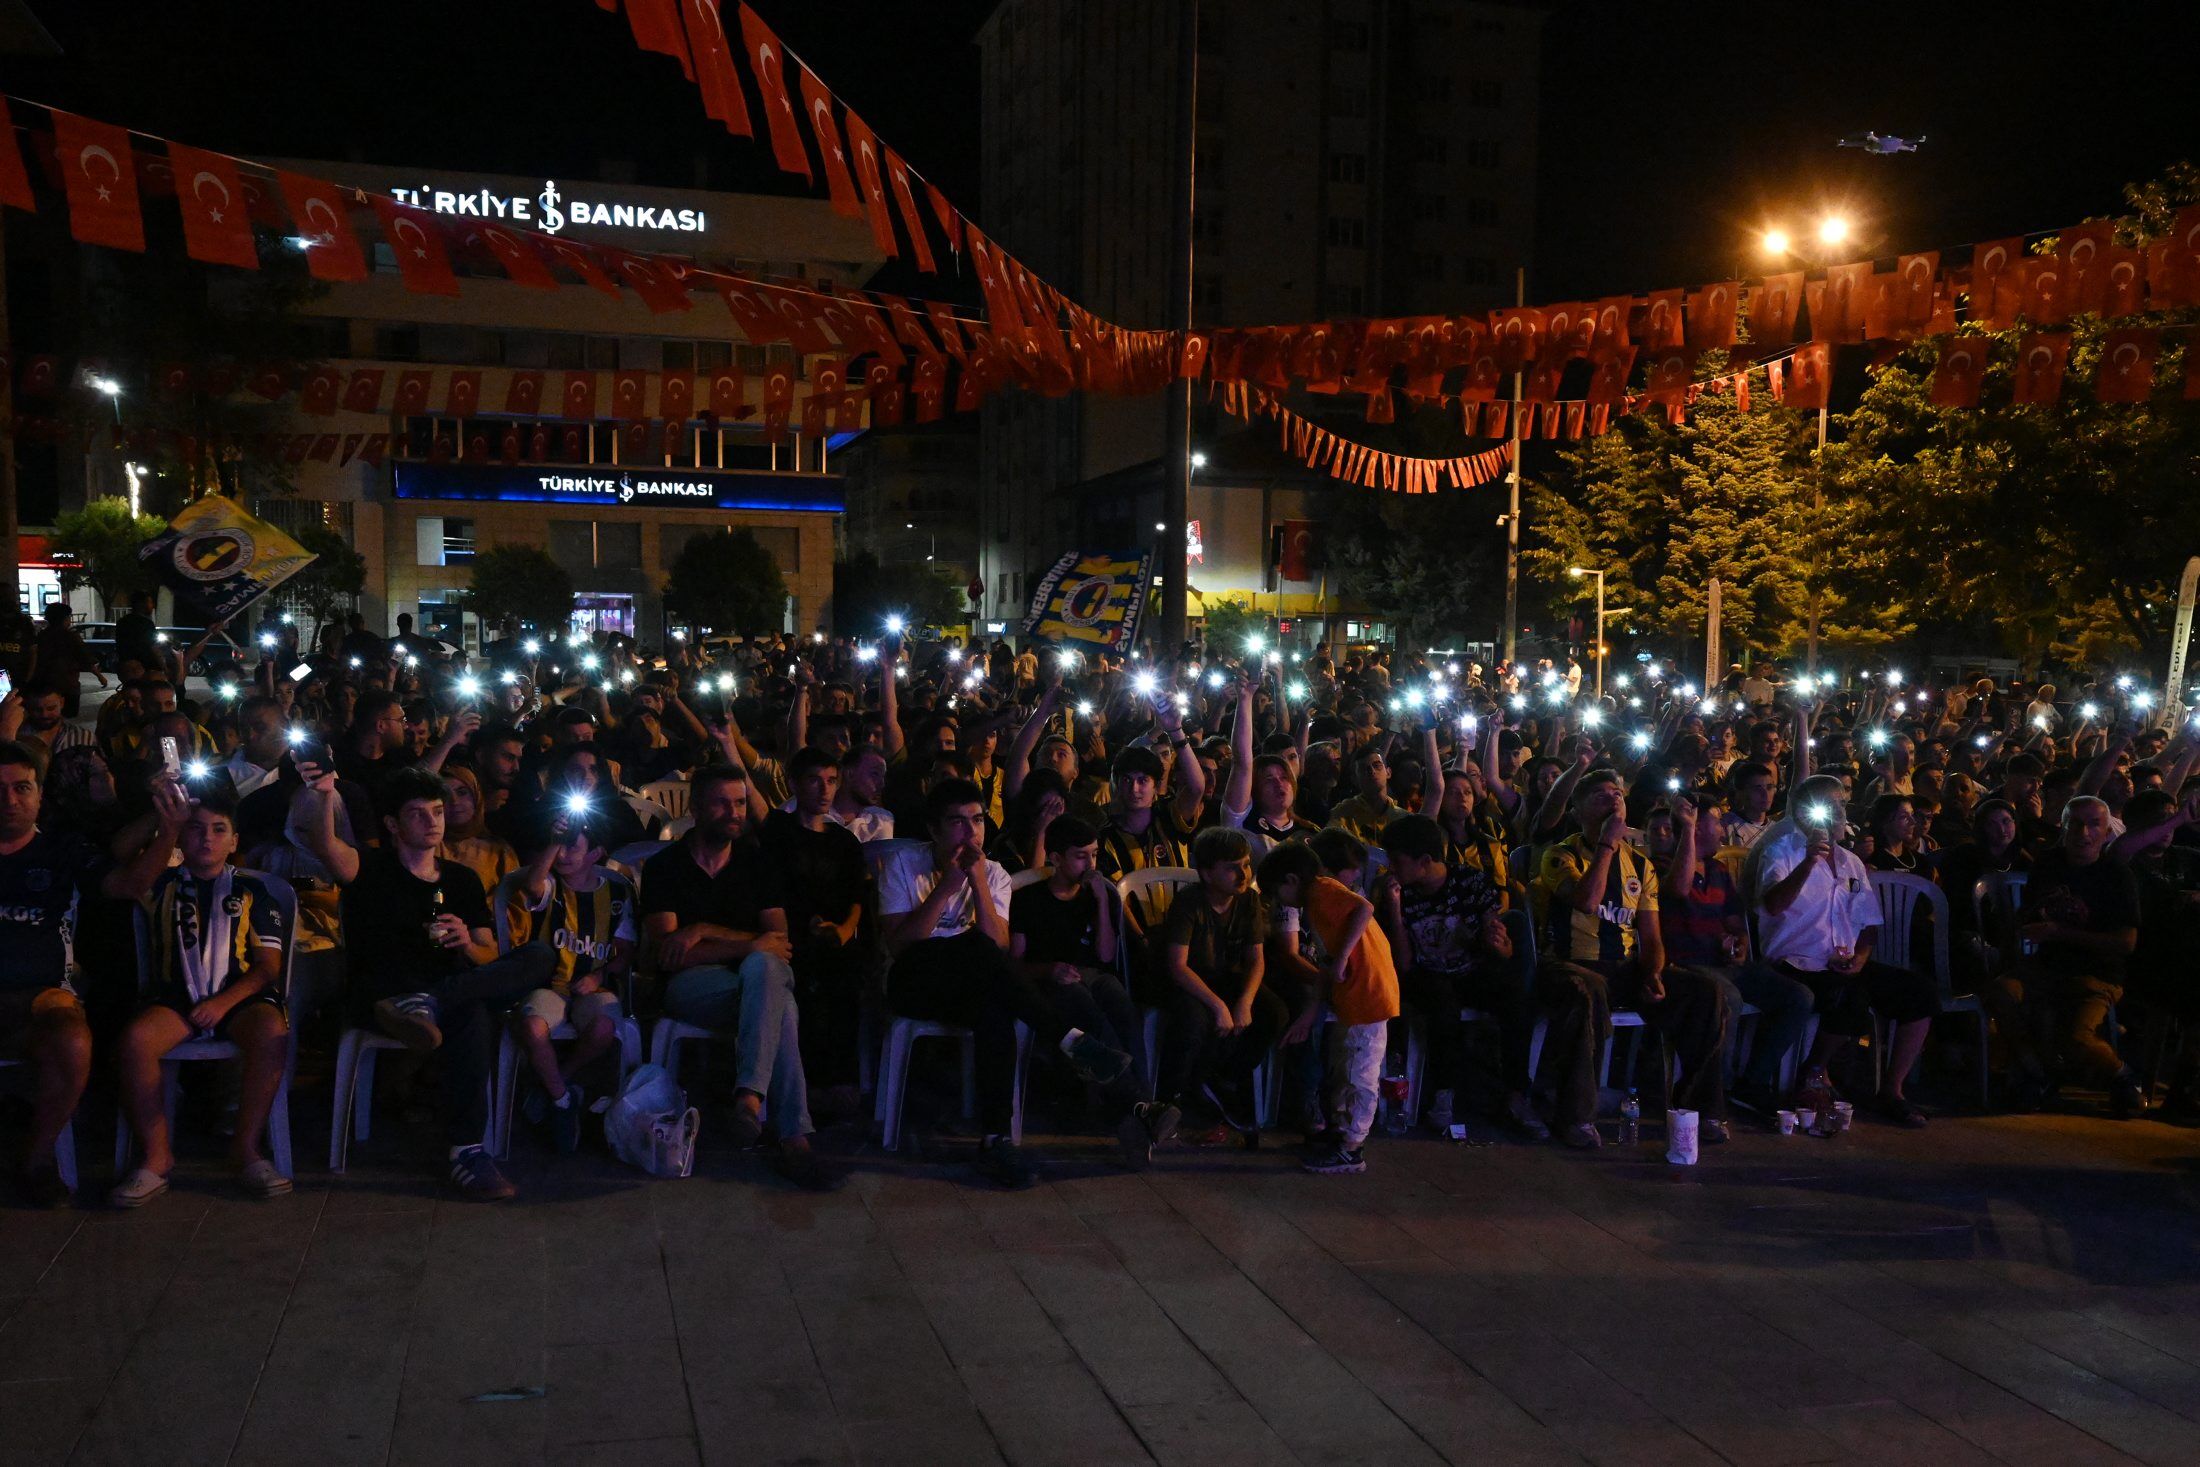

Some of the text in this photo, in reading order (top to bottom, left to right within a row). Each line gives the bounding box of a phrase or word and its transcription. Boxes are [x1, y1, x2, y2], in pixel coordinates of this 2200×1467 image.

[570, 201, 705, 232] BANKASI
[539, 475, 615, 493] TÜRKİYE
[637, 481, 713, 496] BANKASI
